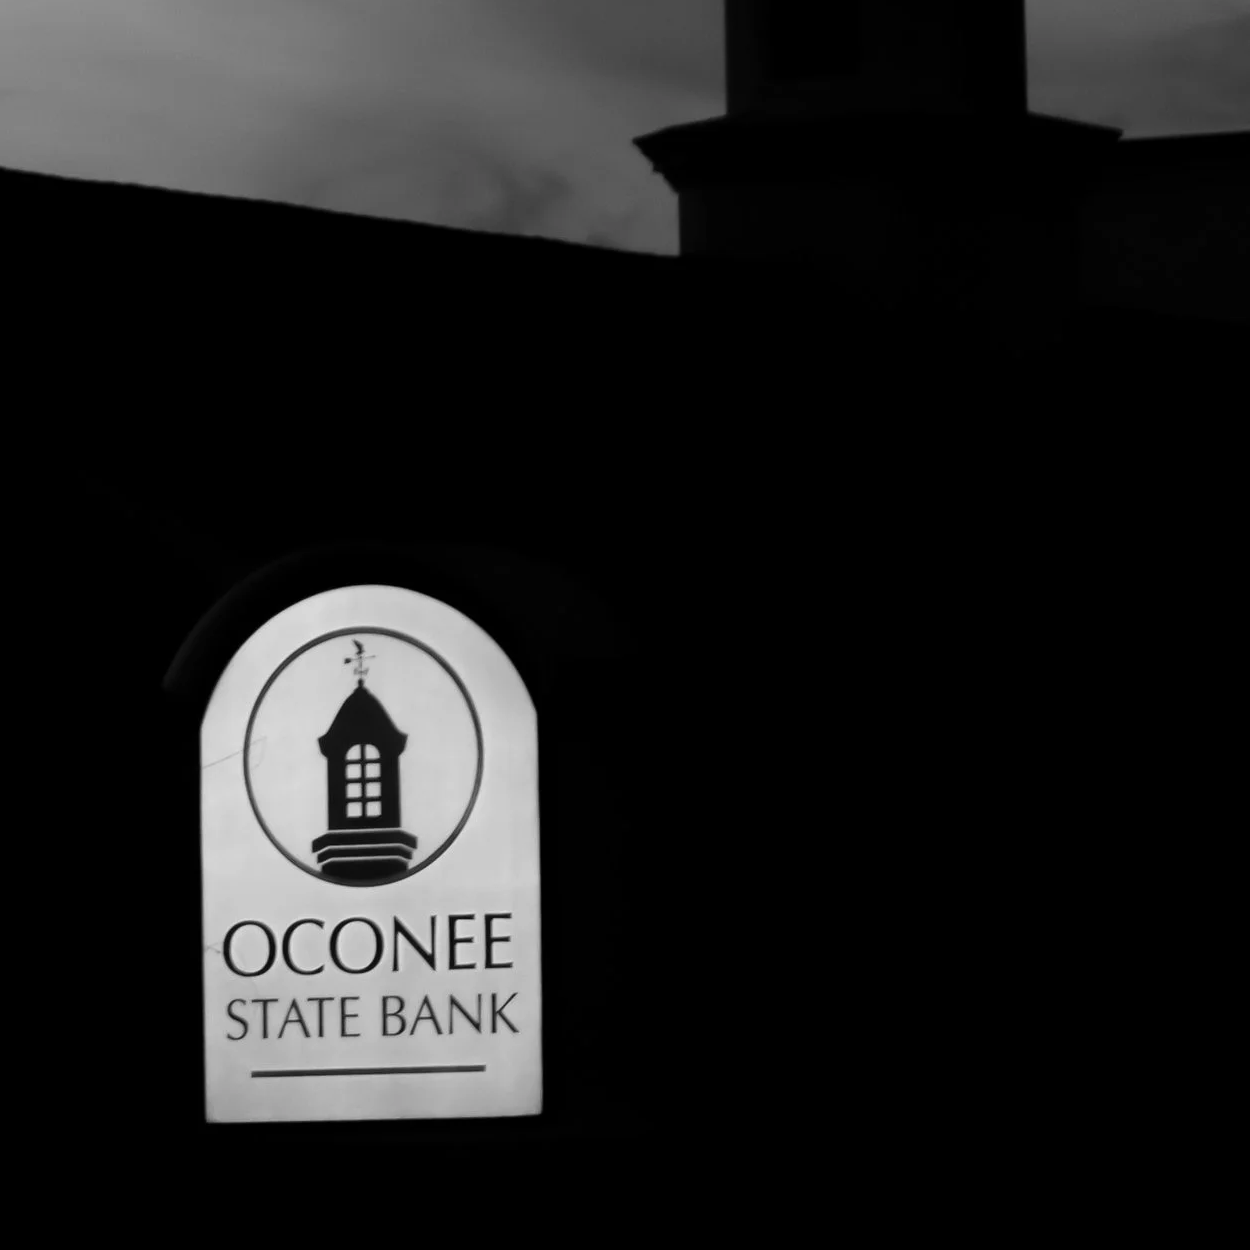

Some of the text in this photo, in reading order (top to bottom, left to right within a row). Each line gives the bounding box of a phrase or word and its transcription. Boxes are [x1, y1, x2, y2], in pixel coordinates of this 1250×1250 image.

[223, 912, 514, 978] OCONEE
[226, 992, 520, 1042] STATE BANK
